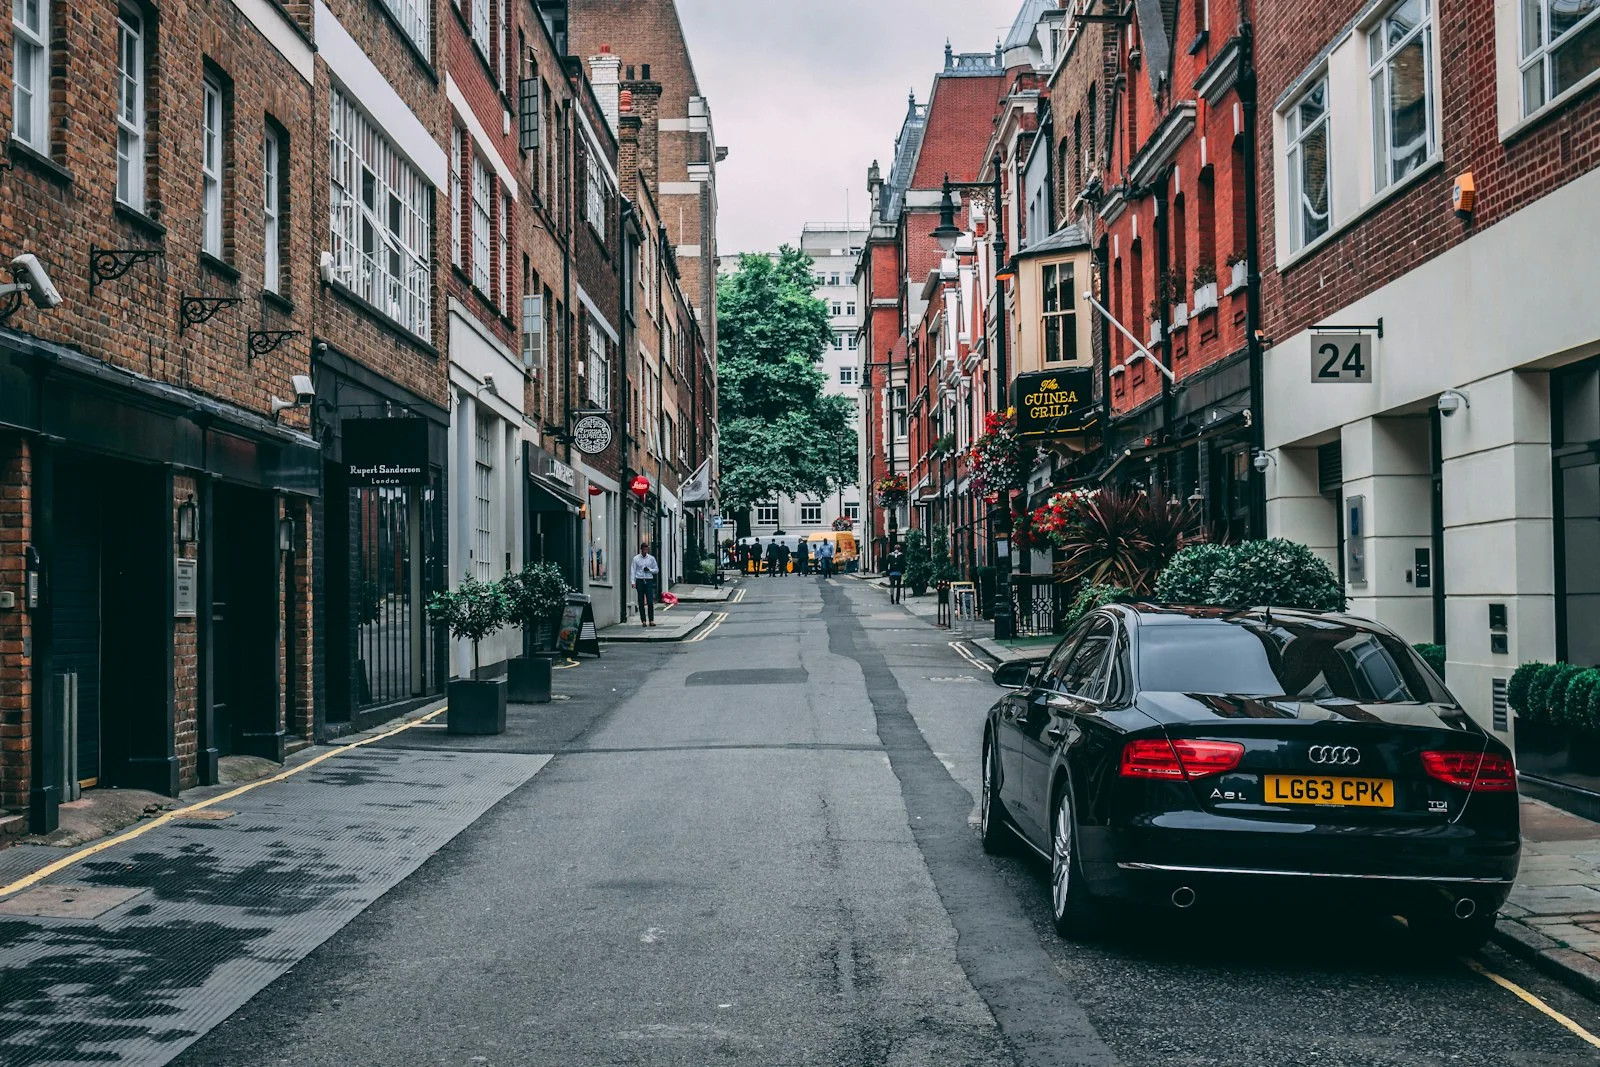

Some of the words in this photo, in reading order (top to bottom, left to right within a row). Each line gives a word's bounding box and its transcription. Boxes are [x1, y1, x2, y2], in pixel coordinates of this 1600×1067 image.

[1318, 343, 1365, 377] 24
[1040, 378, 1060, 392] The
[1024, 391, 1078, 406] GUINEA
[1030, 404, 1073, 419] GRILL
[350, 465, 377, 477] Rupert
[379, 464, 421, 474] Sanderson
[631, 481, 648, 490] Leica
[1275, 778, 1334, 800] LG63
[1341, 780, 1384, 803] CPK
[1427, 800, 1448, 809] TDI
